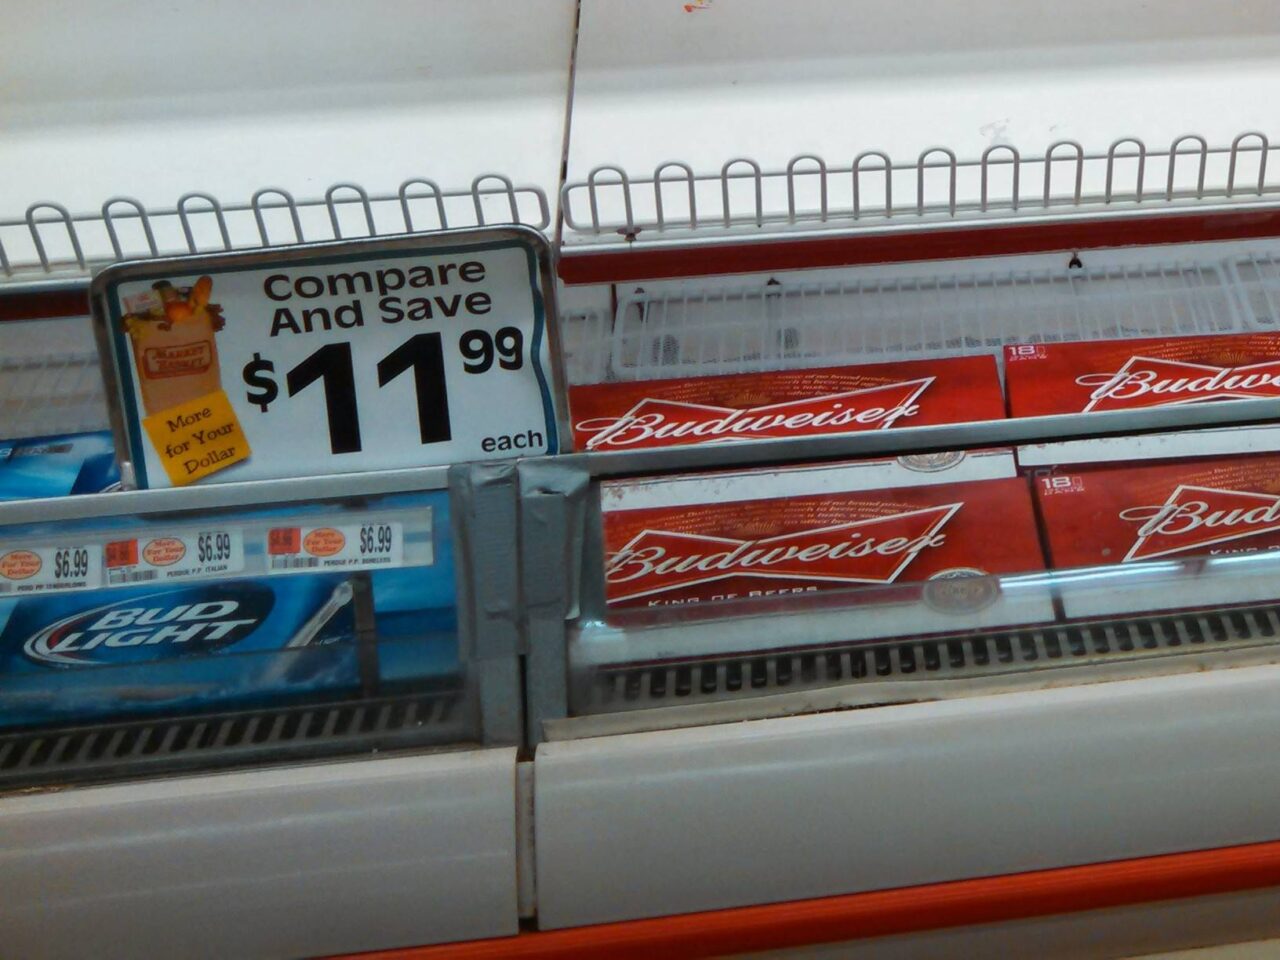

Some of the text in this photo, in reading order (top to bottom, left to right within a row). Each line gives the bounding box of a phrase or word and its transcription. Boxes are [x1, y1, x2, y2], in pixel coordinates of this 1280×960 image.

[263, 259, 486, 302] Compare
[269, 288, 492, 337] And Save
[1010, 345, 1035, 355] 18
[166, 405, 213, 433] More
[575, 403, 919, 451] Budweiser
[165, 420, 235, 460] for Your
[480, 428, 544, 454] each
[183, 443, 237, 478] Dollar
[1042, 476, 1071, 488] 18
[197, 532, 231, 563] $6.99
[360, 525, 392, 554] $6.99
[55, 549, 89, 579] $6.99
[606, 532, 945, 583] Budweiser
[91, 600, 240, 631] BUD
[57, 617, 258, 654] LIGHT
